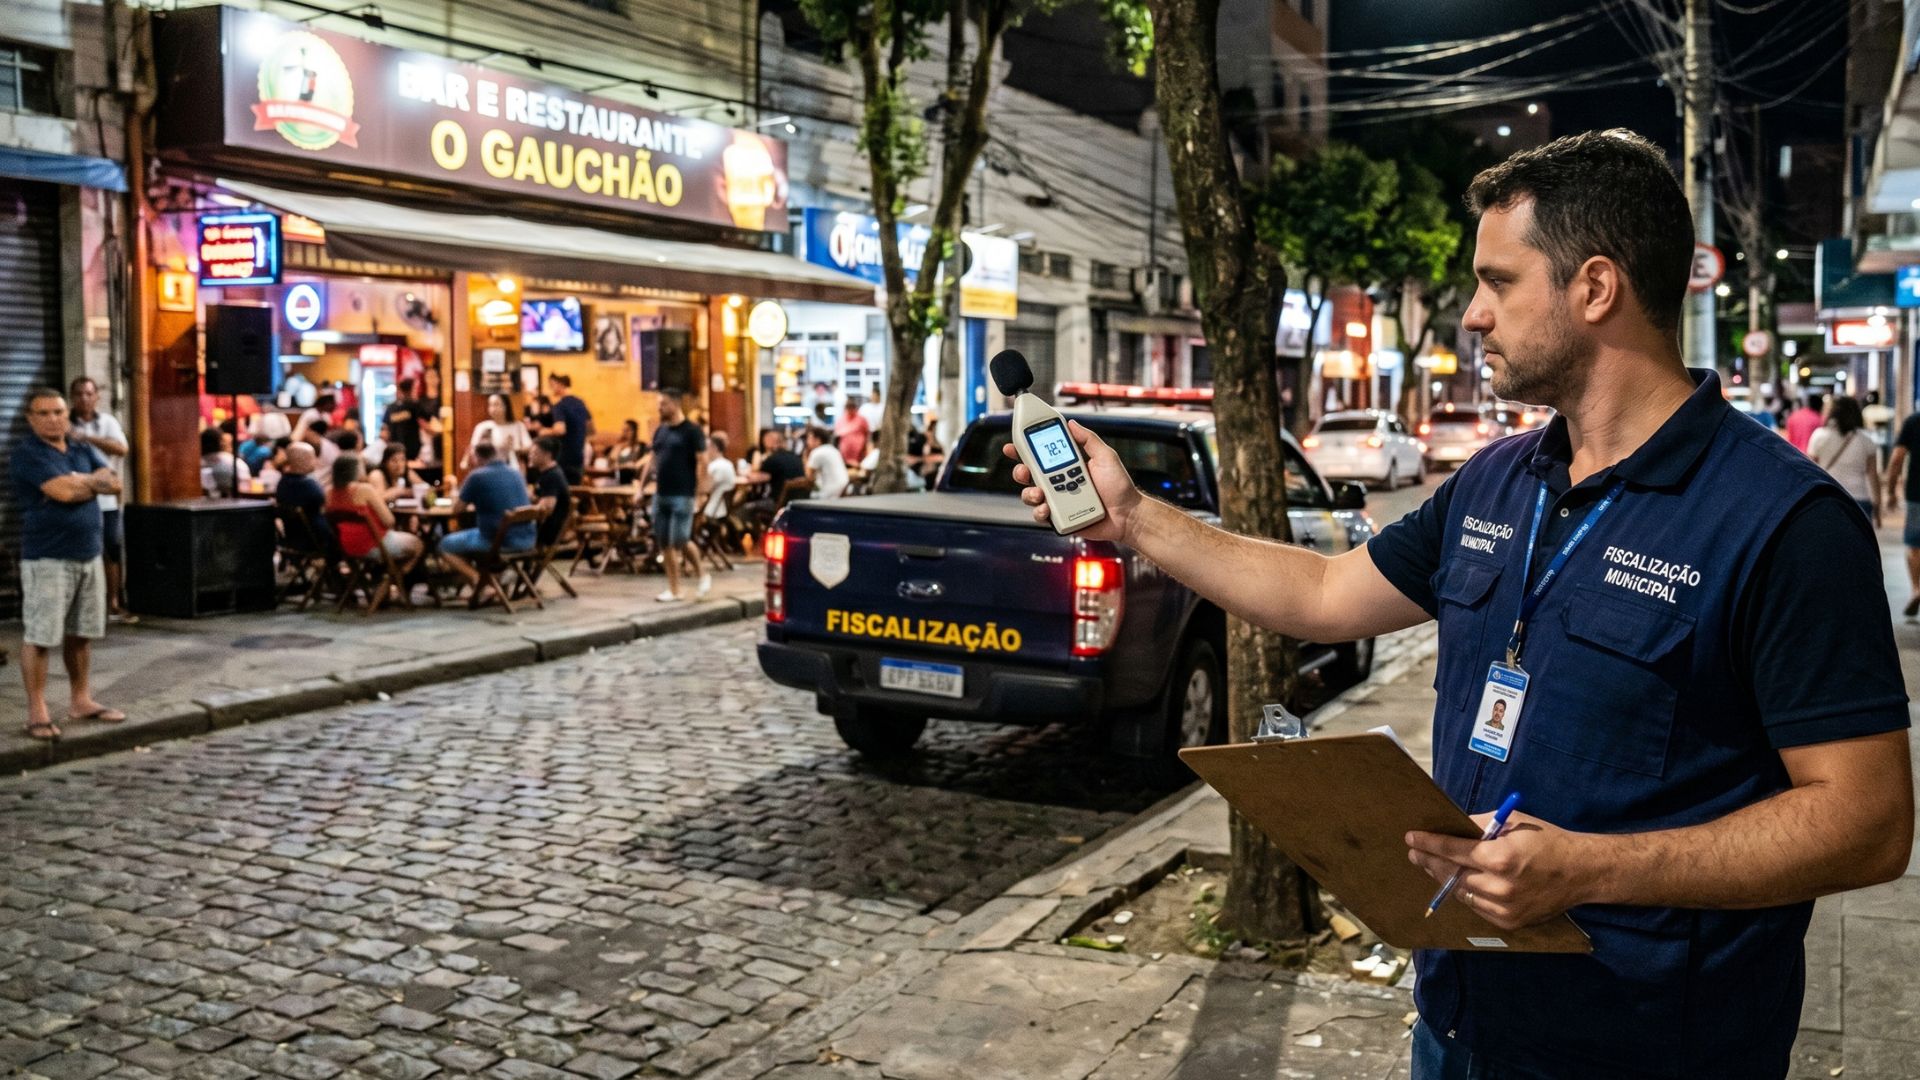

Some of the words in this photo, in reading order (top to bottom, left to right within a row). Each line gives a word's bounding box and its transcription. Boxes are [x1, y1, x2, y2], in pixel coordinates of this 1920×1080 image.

[398, 62, 470, 112] BAR
[477, 79, 499, 118] E
[505, 87, 705, 160] RESTAURANTE
[430, 119, 468, 171] O
[480, 129, 684, 208] GAUCHÃO
[1602, 545, 1701, 587] FISCALIZAÇÃO
[826, 609, 1022, 653] FISCALIZAÇÃO
